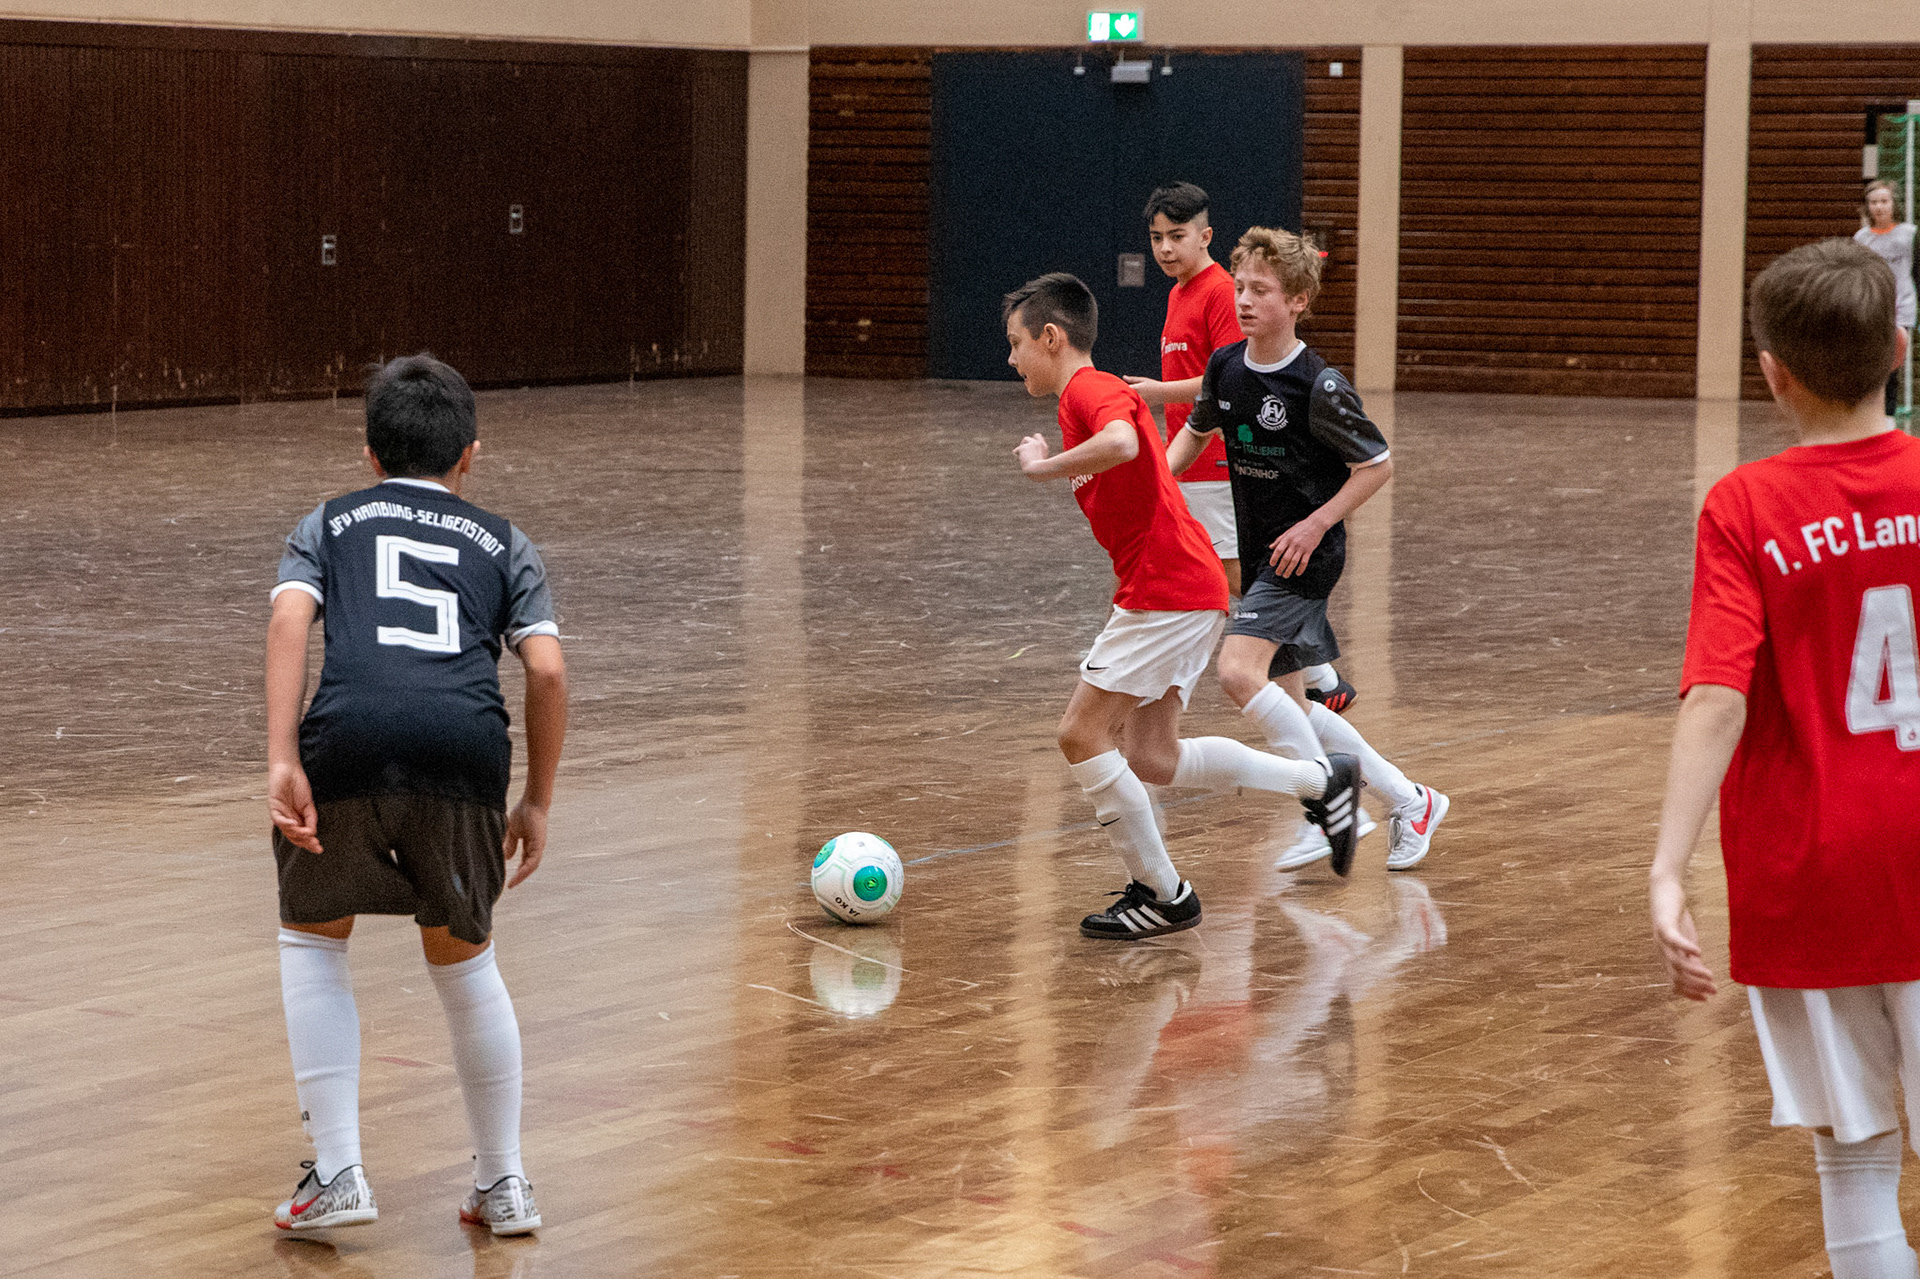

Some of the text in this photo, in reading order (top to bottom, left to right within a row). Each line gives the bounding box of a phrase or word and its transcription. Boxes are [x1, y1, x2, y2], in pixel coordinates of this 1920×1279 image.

[328, 501, 505, 557] JFV HAINBURG-SELIGENSTADT
[1763, 511, 1920, 575] 1. FC Lan
[375, 535, 462, 653] 5
[1845, 584, 1920, 751] 4
